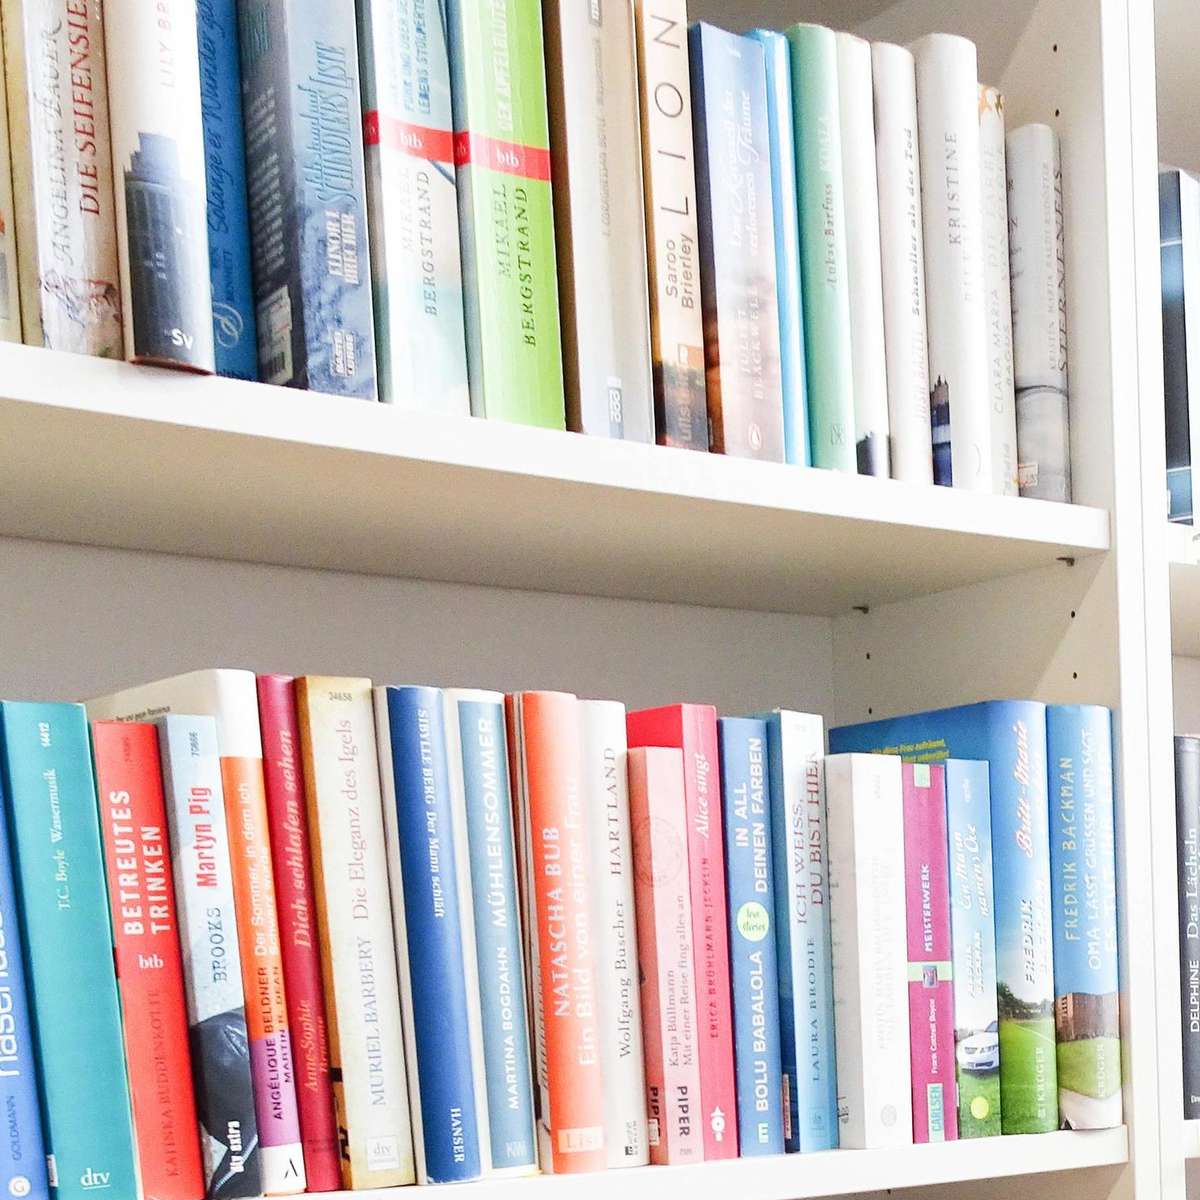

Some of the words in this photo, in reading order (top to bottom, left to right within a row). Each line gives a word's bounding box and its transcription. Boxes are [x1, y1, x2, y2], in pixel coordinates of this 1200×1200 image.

[399, 131, 423, 149] btb
[650, 15, 688, 215] LION
[497, 149, 520, 168] btb
[944, 132, 962, 246] KRISTINE
[416, 171, 437, 317] BERGSTRAND
[515, 188, 537, 346] BERGSTRAND
[665, 239, 678, 298] Saroo
[679, 233, 695, 309] Brierley
[278, 729, 298, 793] sehen
[336, 718, 357, 764] Igels
[688, 751, 708, 795] singt
[749, 737, 765, 815] FARBEN
[188, 786, 212, 815] Pig
[341, 770, 358, 800] des
[604, 747, 622, 875] HARTLAND
[695, 798, 711, 837] Alice
[733, 782, 747, 819] ALL
[1059, 757, 1076, 851] BACKMAN
[192, 823, 218, 888] Martyn
[284, 799, 306, 892] schlafen
[346, 806, 367, 881] Eleganz
[477, 717, 508, 928] MÜHLENSOMMER
[543, 826, 561, 876] BUB
[735, 828, 748, 848] IN
[753, 822, 768, 893] DEINEN
[109, 790, 144, 935] BETREUTES
[141, 826, 170, 935] TRINKEN
[1183, 827, 1198, 898] Lächeln
[292, 897, 312, 948] Dich
[352, 887, 369, 920] Die
[613, 900, 627, 970] Büscher
[921, 864, 933, 952] MEISTERWERK
[1063, 862, 1080, 942] FREDRIK
[1185, 907, 1200, 939] Das
[139, 954, 163, 969] btb
[206, 906, 228, 983] BROOKS
[547, 887, 570, 1016] NATASCHA
[258, 967, 274, 1033] BELDNER
[496, 946, 514, 1031] BOGDAHN
[615, 977, 631, 1059] Wolfgang
[749, 950, 766, 1052] BABALOLA
[1190, 959, 1200, 1032] DELPHINE
[265, 1037, 283, 1120] ANGÉLIQUE
[501, 1037, 520, 1109] MARTINA
[754, 1061, 769, 1112] BOLU
[930, 1085, 942, 1132] CARLSEN
[450, 1107, 463, 1163] HANSER
[677, 1086, 689, 1136] PIPER
[80, 1167, 110, 1189] dtv
